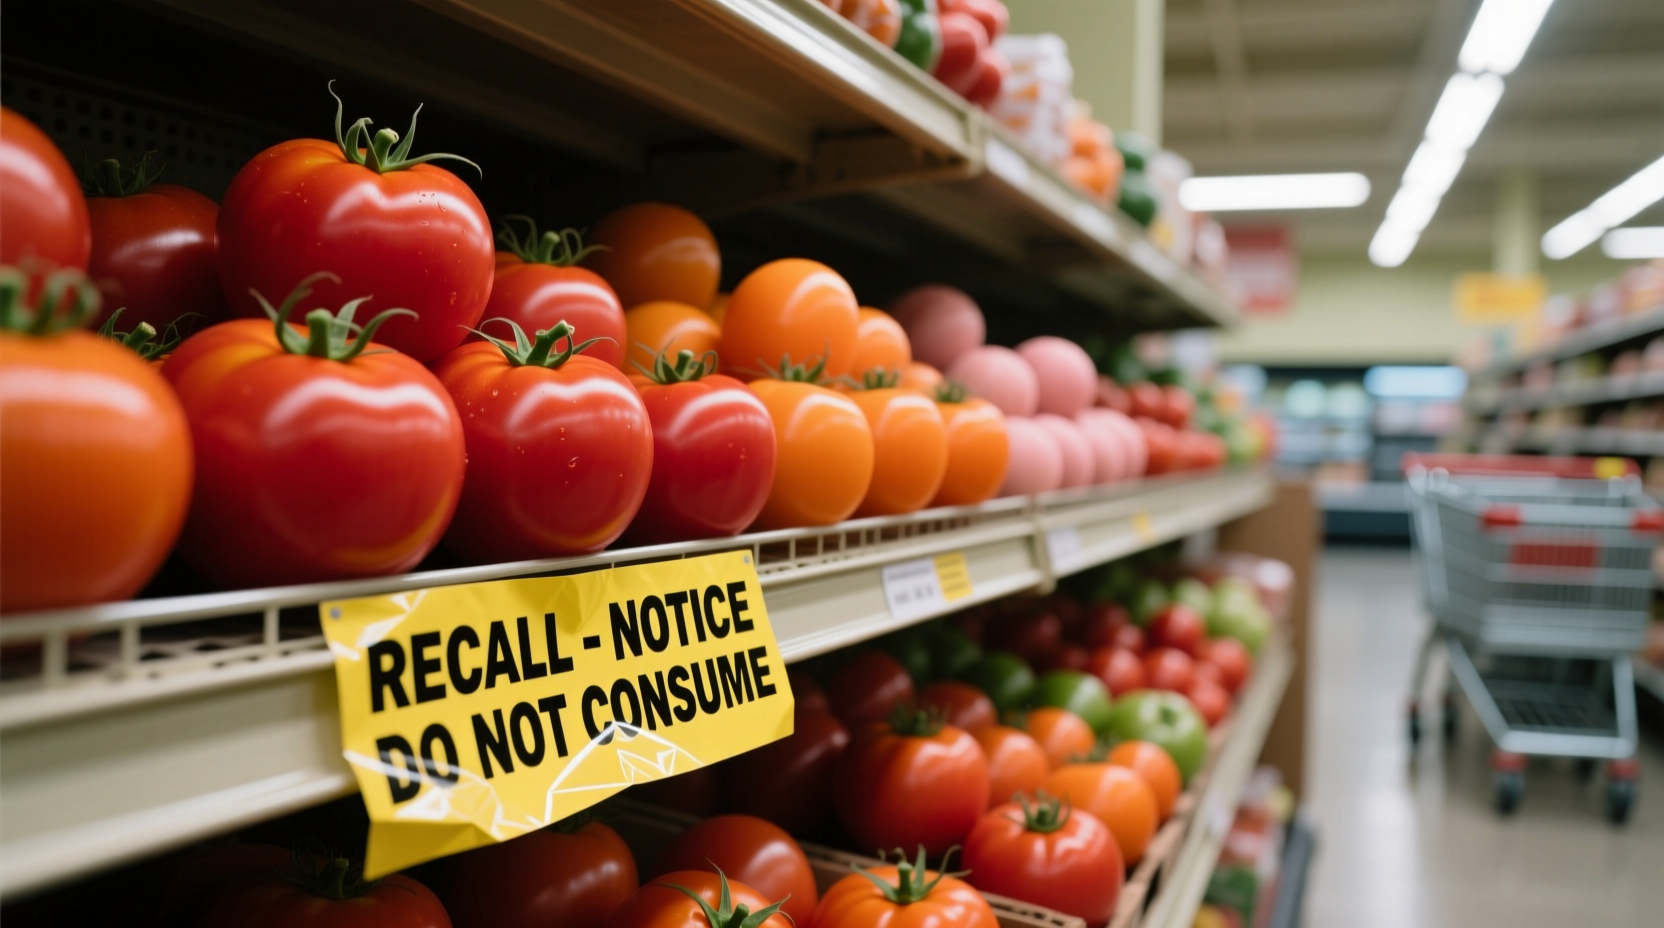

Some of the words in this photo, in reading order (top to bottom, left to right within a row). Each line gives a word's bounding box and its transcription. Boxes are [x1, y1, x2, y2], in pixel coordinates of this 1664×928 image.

[368, 612, 573, 714] RECALL
[609, 580, 754, 661] NOTICE
[376, 723, 459, 804] DO
[471, 694, 568, 779] NOT
[581, 645, 777, 746] CONSUME
